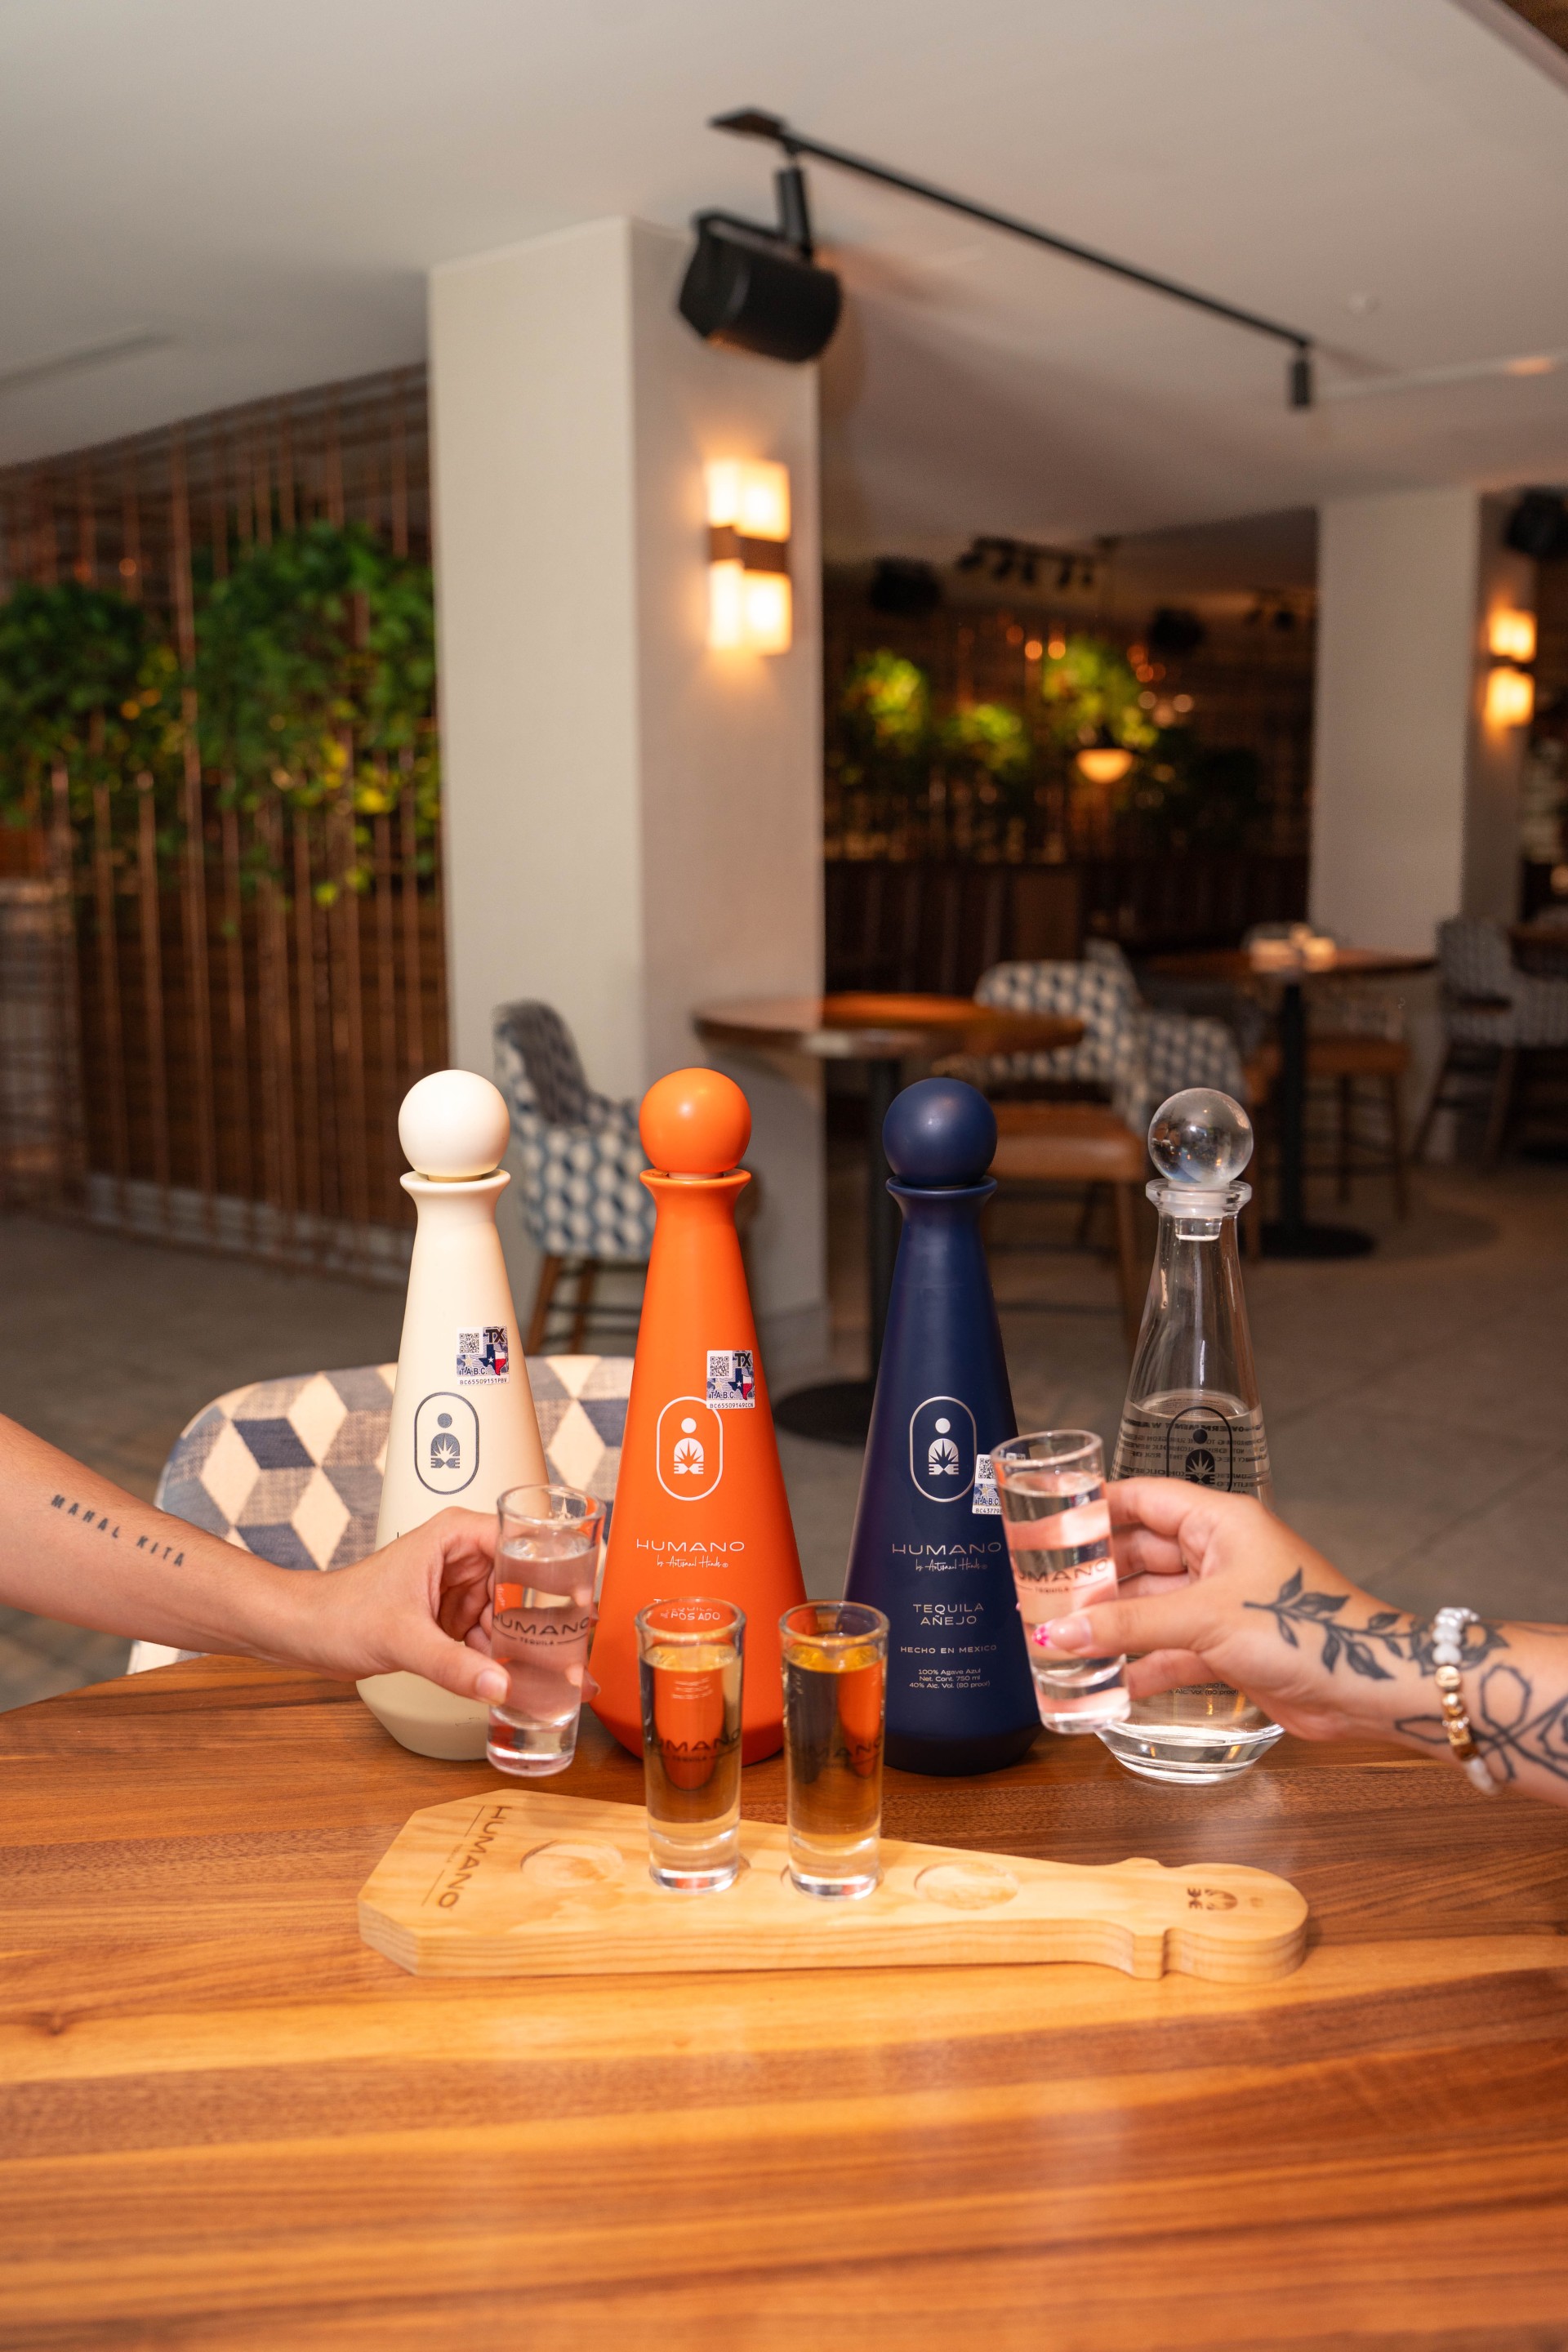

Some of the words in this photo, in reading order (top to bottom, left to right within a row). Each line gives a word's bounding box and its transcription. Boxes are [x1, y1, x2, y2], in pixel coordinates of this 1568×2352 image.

[486, 1328, 505, 1343] TX
[734, 1352, 751, 1367] TX
[51, 1494, 121, 1539] MAHAL
[136, 1535, 185, 1567] KITA
[636, 1539, 745, 1552] HUMANO
[892, 1542, 1001, 1555] HUMANO
[912, 1602, 984, 1615] TEQUILA
[920, 1615, 978, 1625] AÑEJO
[959, 1645, 997, 1653] MEXICO
[438, 1806, 513, 1908] HUMANO
